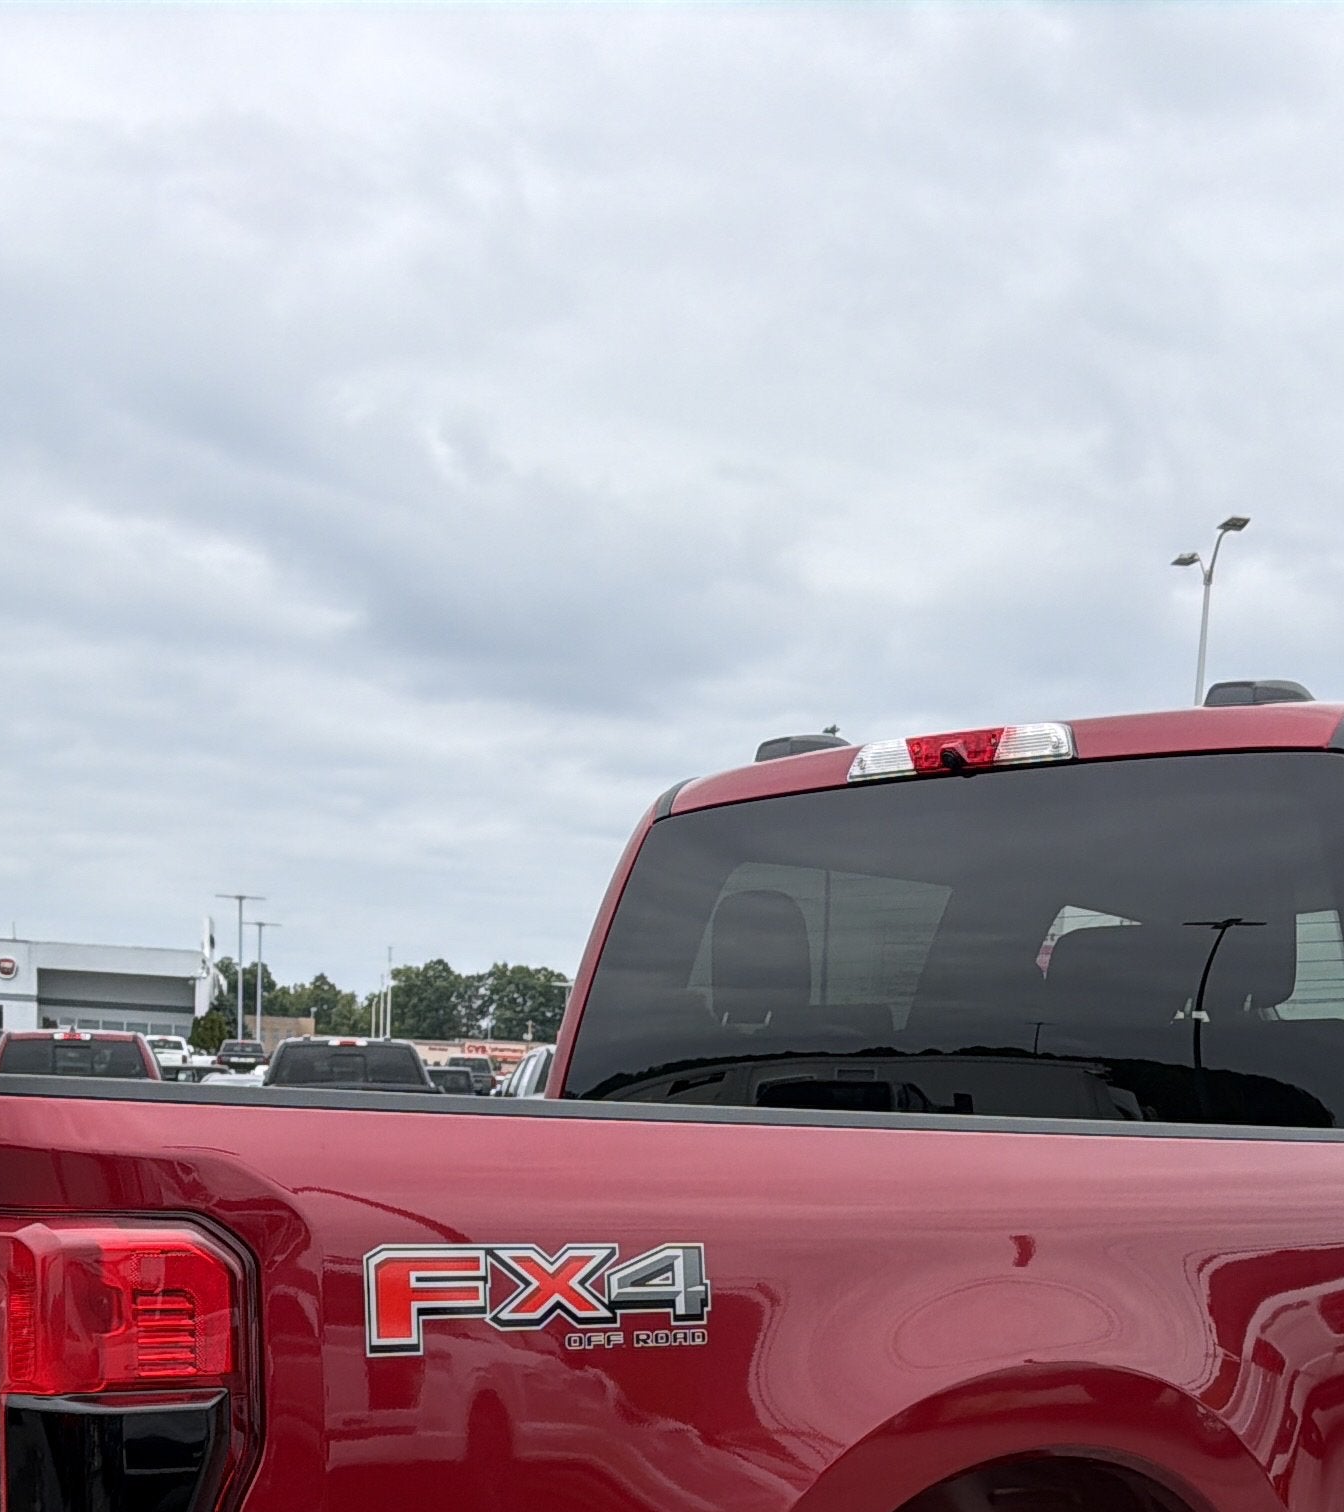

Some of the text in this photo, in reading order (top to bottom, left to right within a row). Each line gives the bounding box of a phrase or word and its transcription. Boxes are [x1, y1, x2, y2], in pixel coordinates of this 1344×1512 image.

[363, 1243, 711, 1357] FX4
[565, 1328, 708, 1350] OFF ROAD
